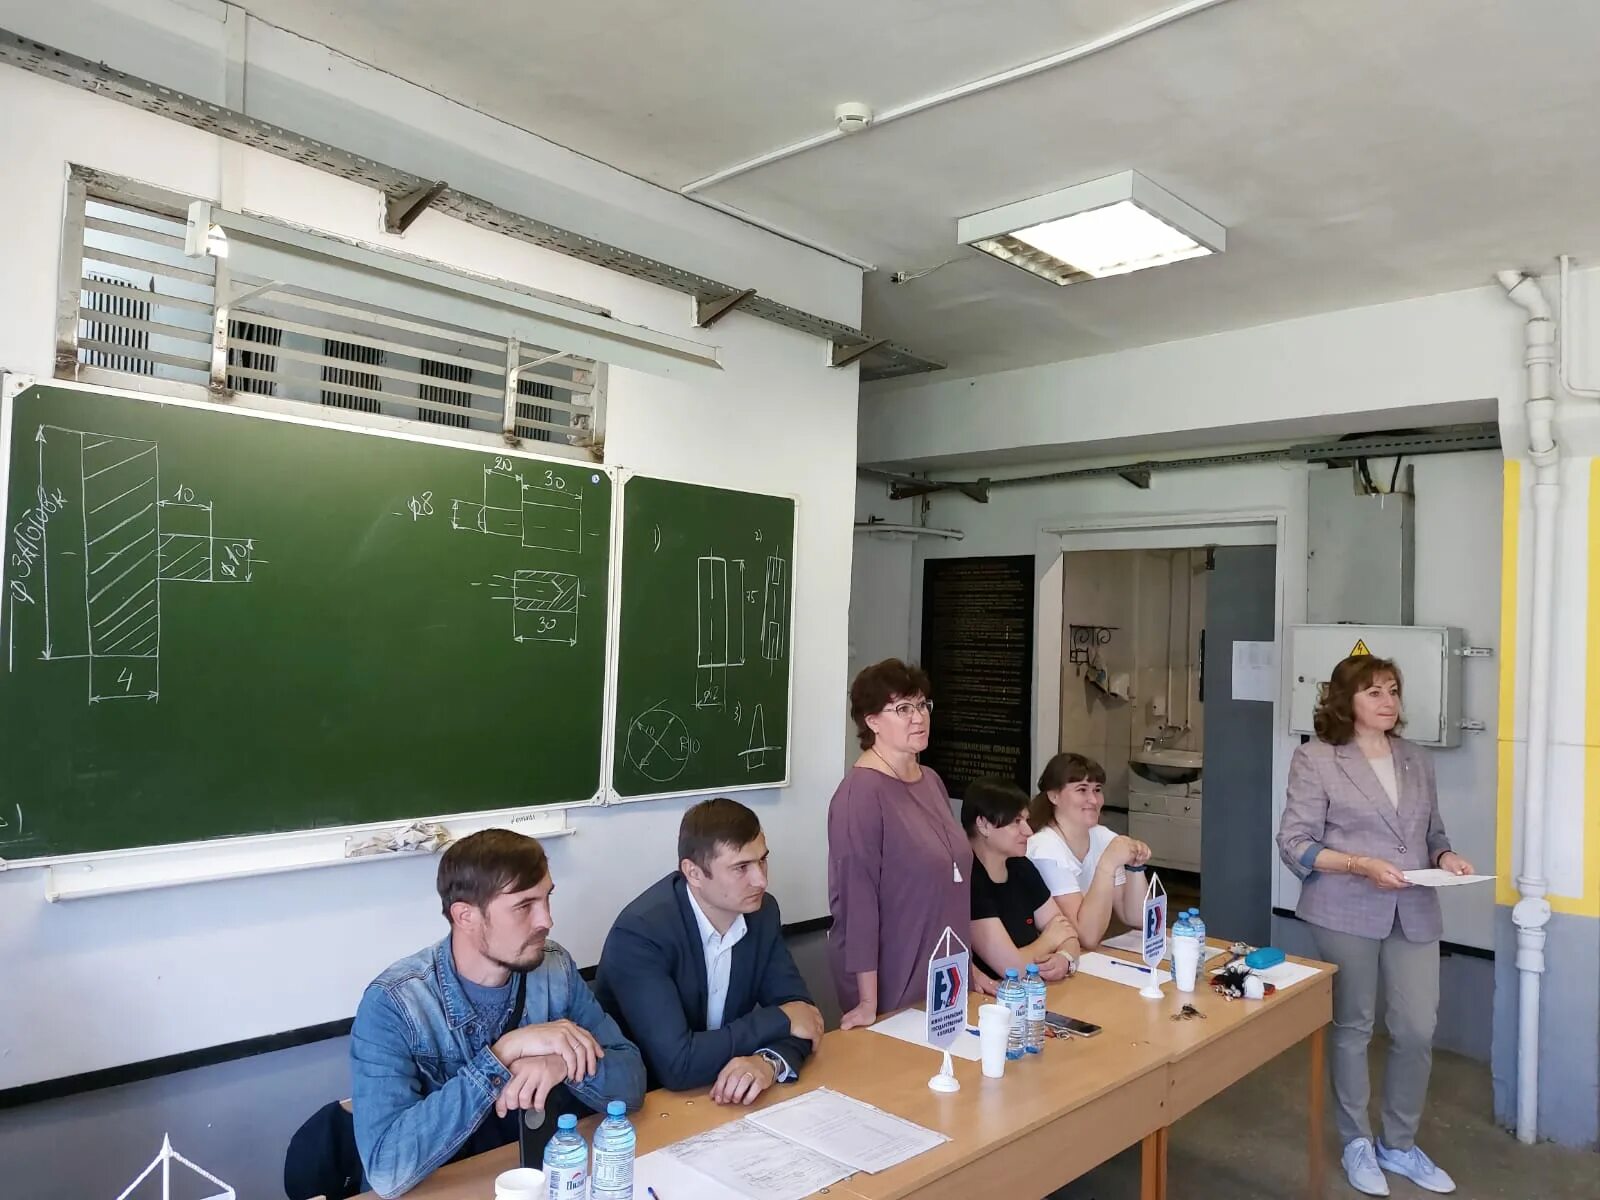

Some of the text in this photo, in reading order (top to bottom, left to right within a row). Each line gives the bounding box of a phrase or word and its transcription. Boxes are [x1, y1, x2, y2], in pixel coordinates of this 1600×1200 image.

[494, 456, 513, 471] 20
[544, 470, 566, 489] 30
[174, 483, 195, 502] 10
[537, 616, 556, 633] 30
[117, 667, 133, 692] 4
